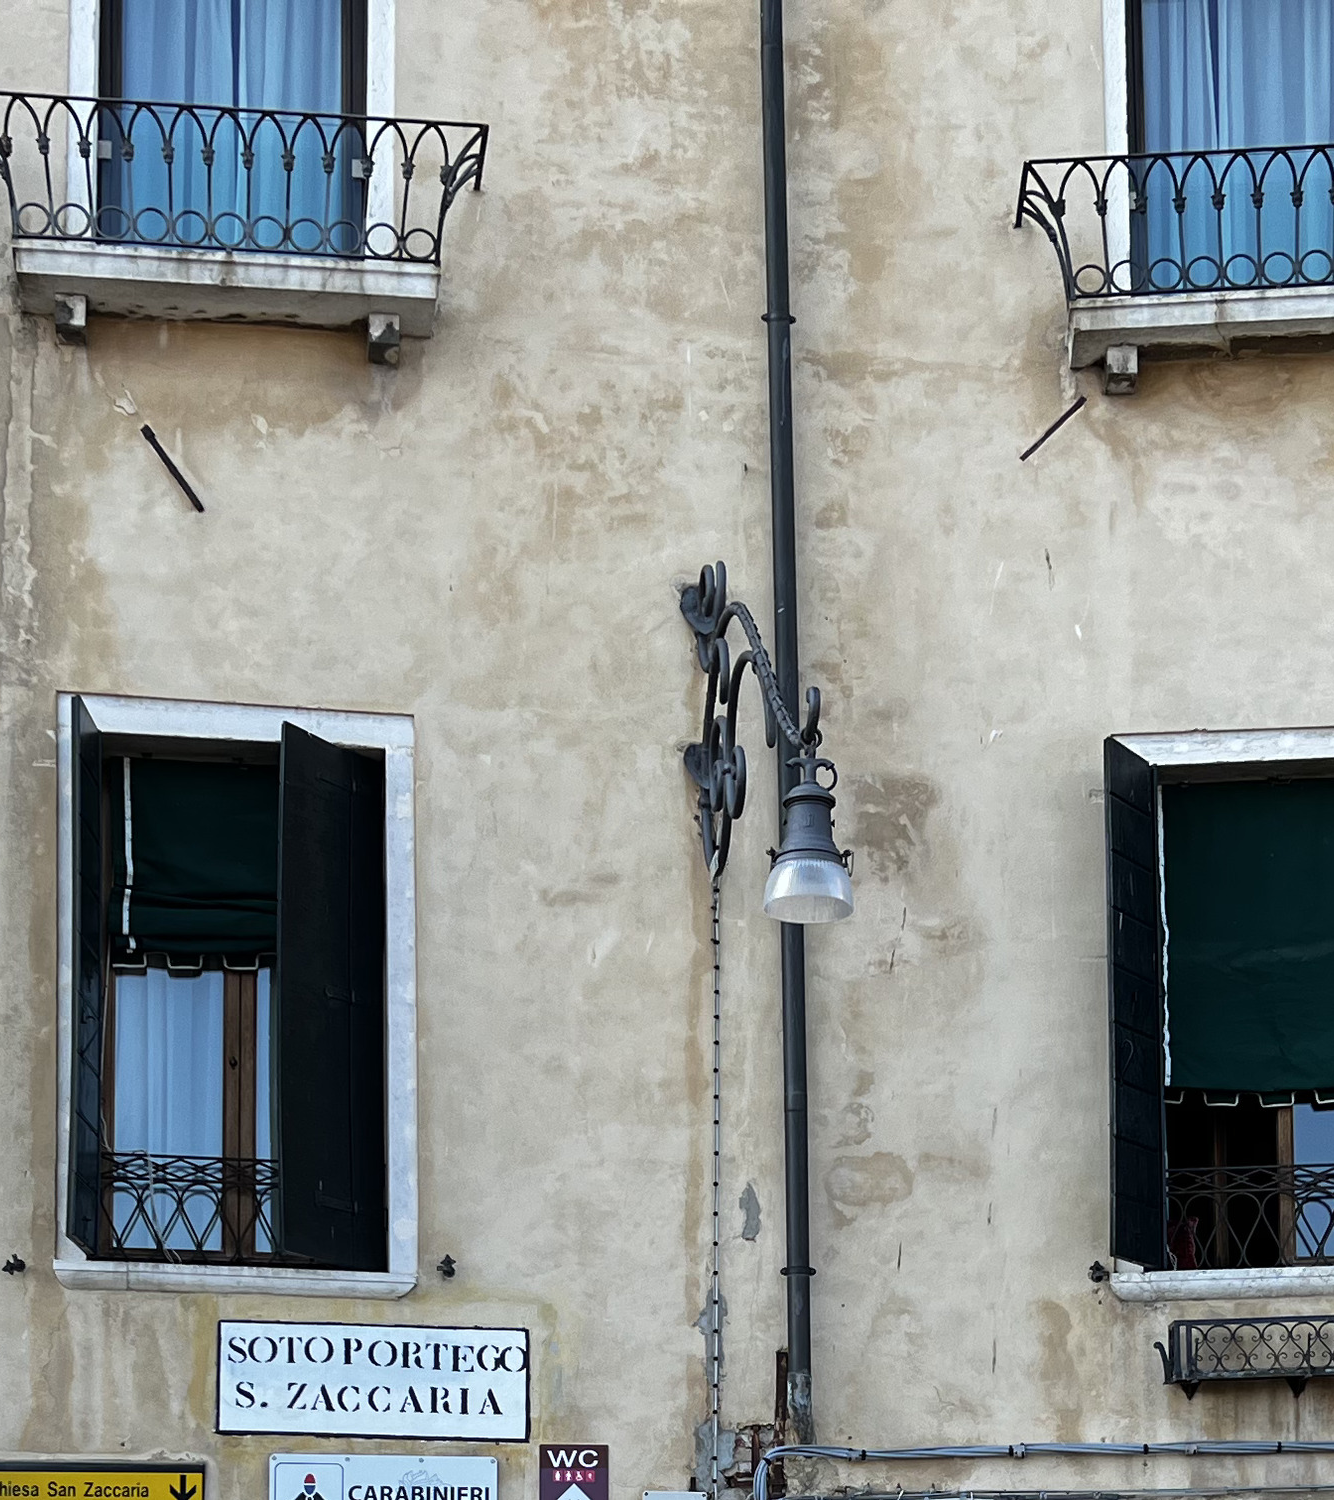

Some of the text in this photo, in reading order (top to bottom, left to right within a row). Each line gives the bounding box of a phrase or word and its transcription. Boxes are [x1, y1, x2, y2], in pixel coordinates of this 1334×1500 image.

[235, 1381, 503, 1415] S. ZACCARIA
[547, 1450, 599, 1468] WC
[47, 1481, 76, 1497] San
[83, 1482, 149, 1498] Zaccaria
